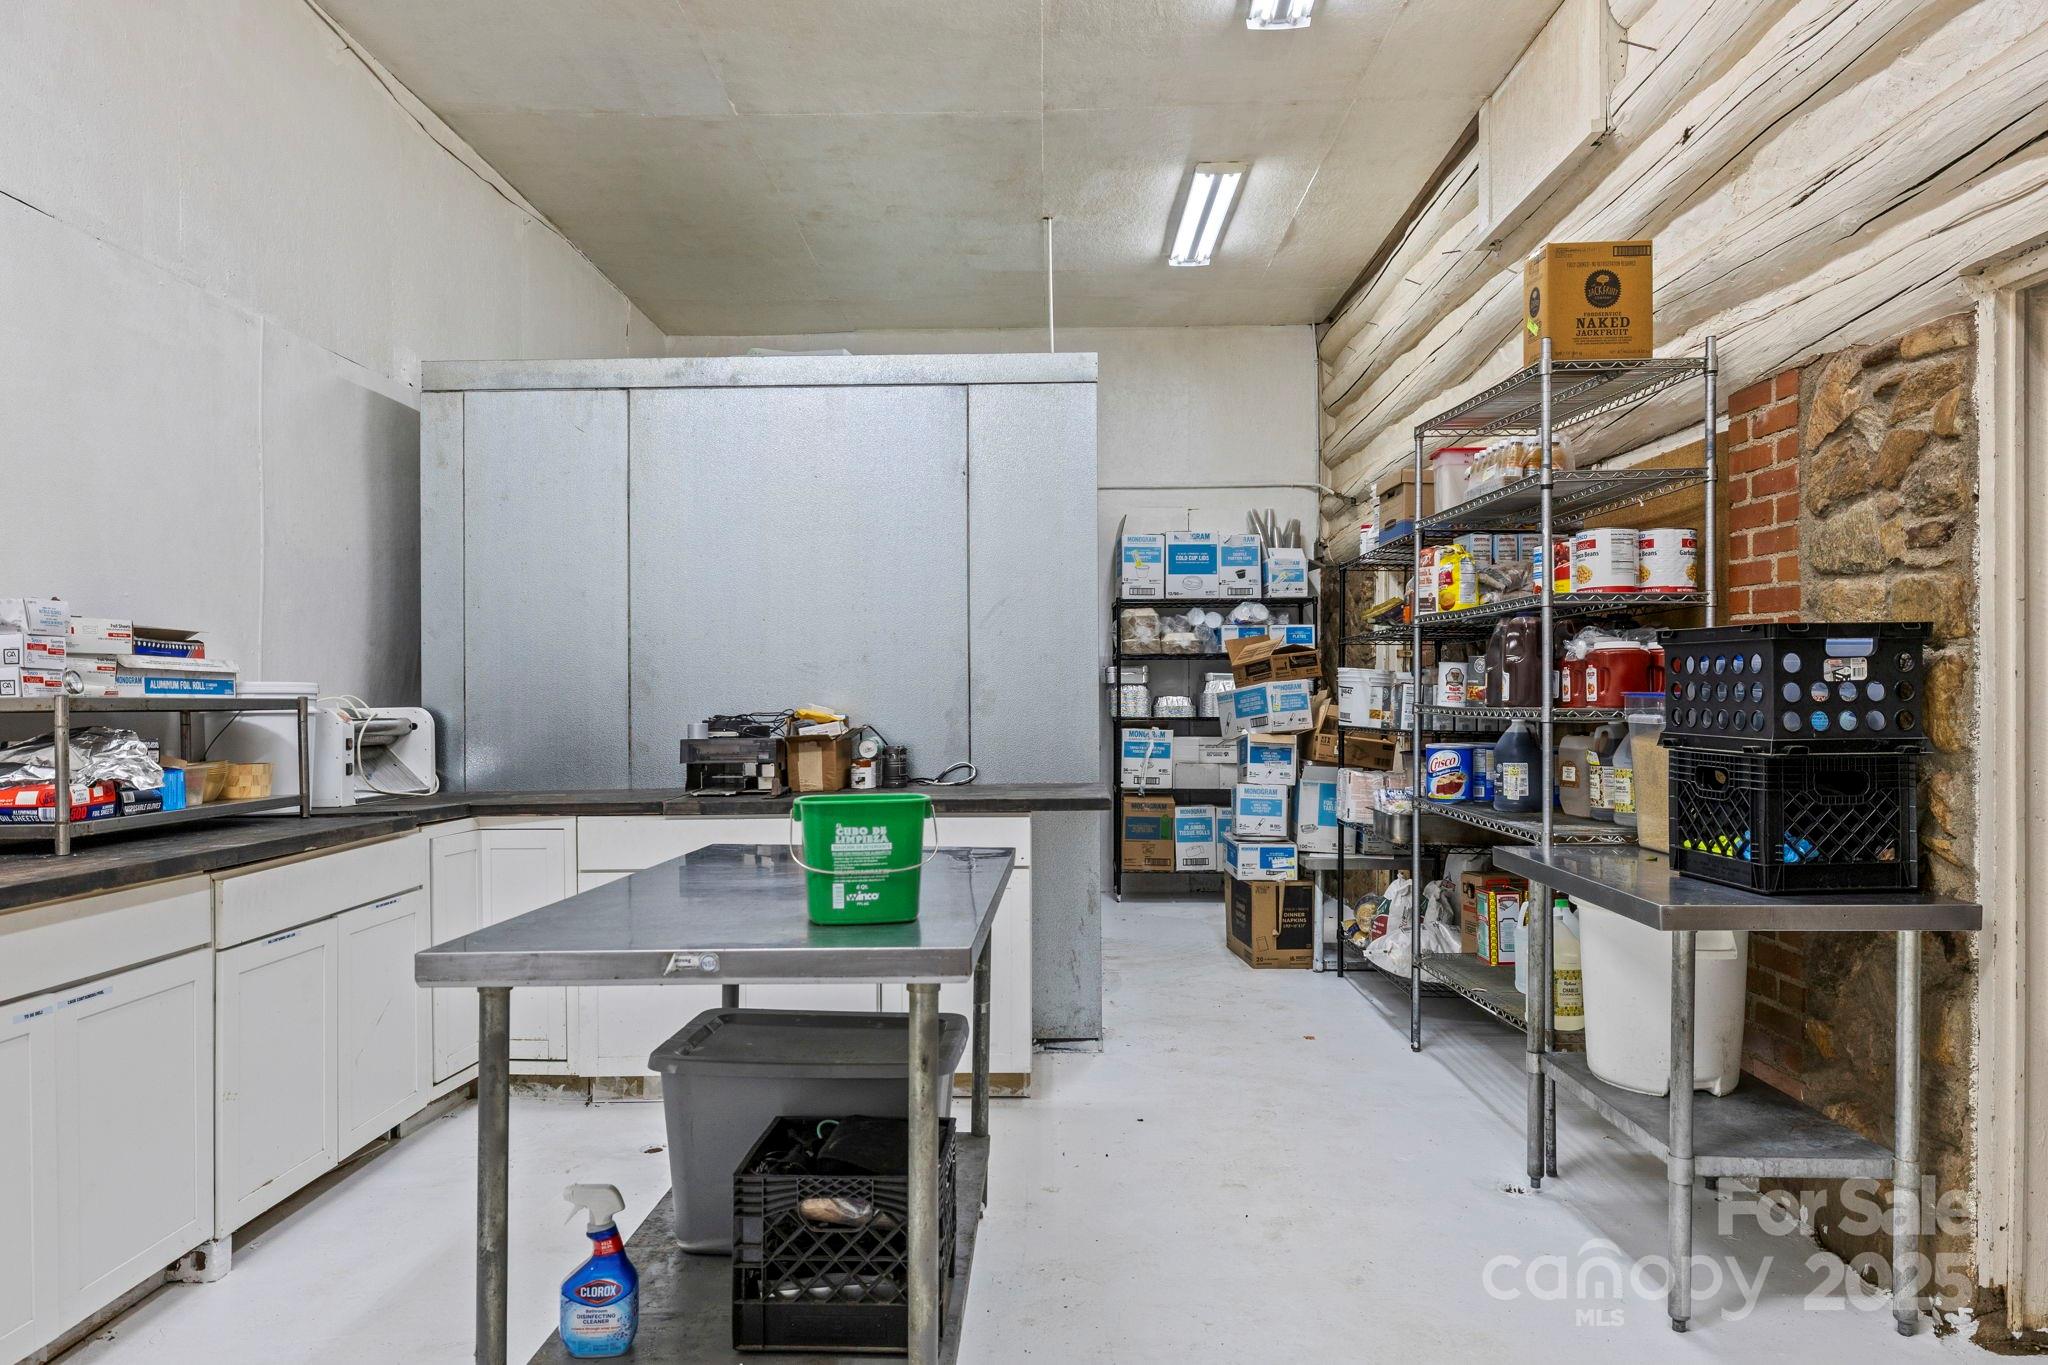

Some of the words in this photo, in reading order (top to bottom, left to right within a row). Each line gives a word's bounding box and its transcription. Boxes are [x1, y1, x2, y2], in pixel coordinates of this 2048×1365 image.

[1575, 316, 1631, 329] NAKED
[1575, 328, 1629, 337] JACKFRUIT
[1641, 550, 1658, 558] Beans
[115, 675, 143, 685] MONOGRAM
[150, 679, 180, 689] ALUMINUM
[180, 680, 191, 689] FOIL
[192, 681, 206, 690] ROLL
[1430, 756, 1456, 772] Crisco
[1243, 787, 1278, 796] MONOGRAM
[71, 806, 88, 820] 500
[835, 826, 868, 835] CUBO
[872, 825, 887, 835] DE
[835, 834, 889, 844] LIMPIEZA
[580, 1284, 617, 1298] CLOROX
